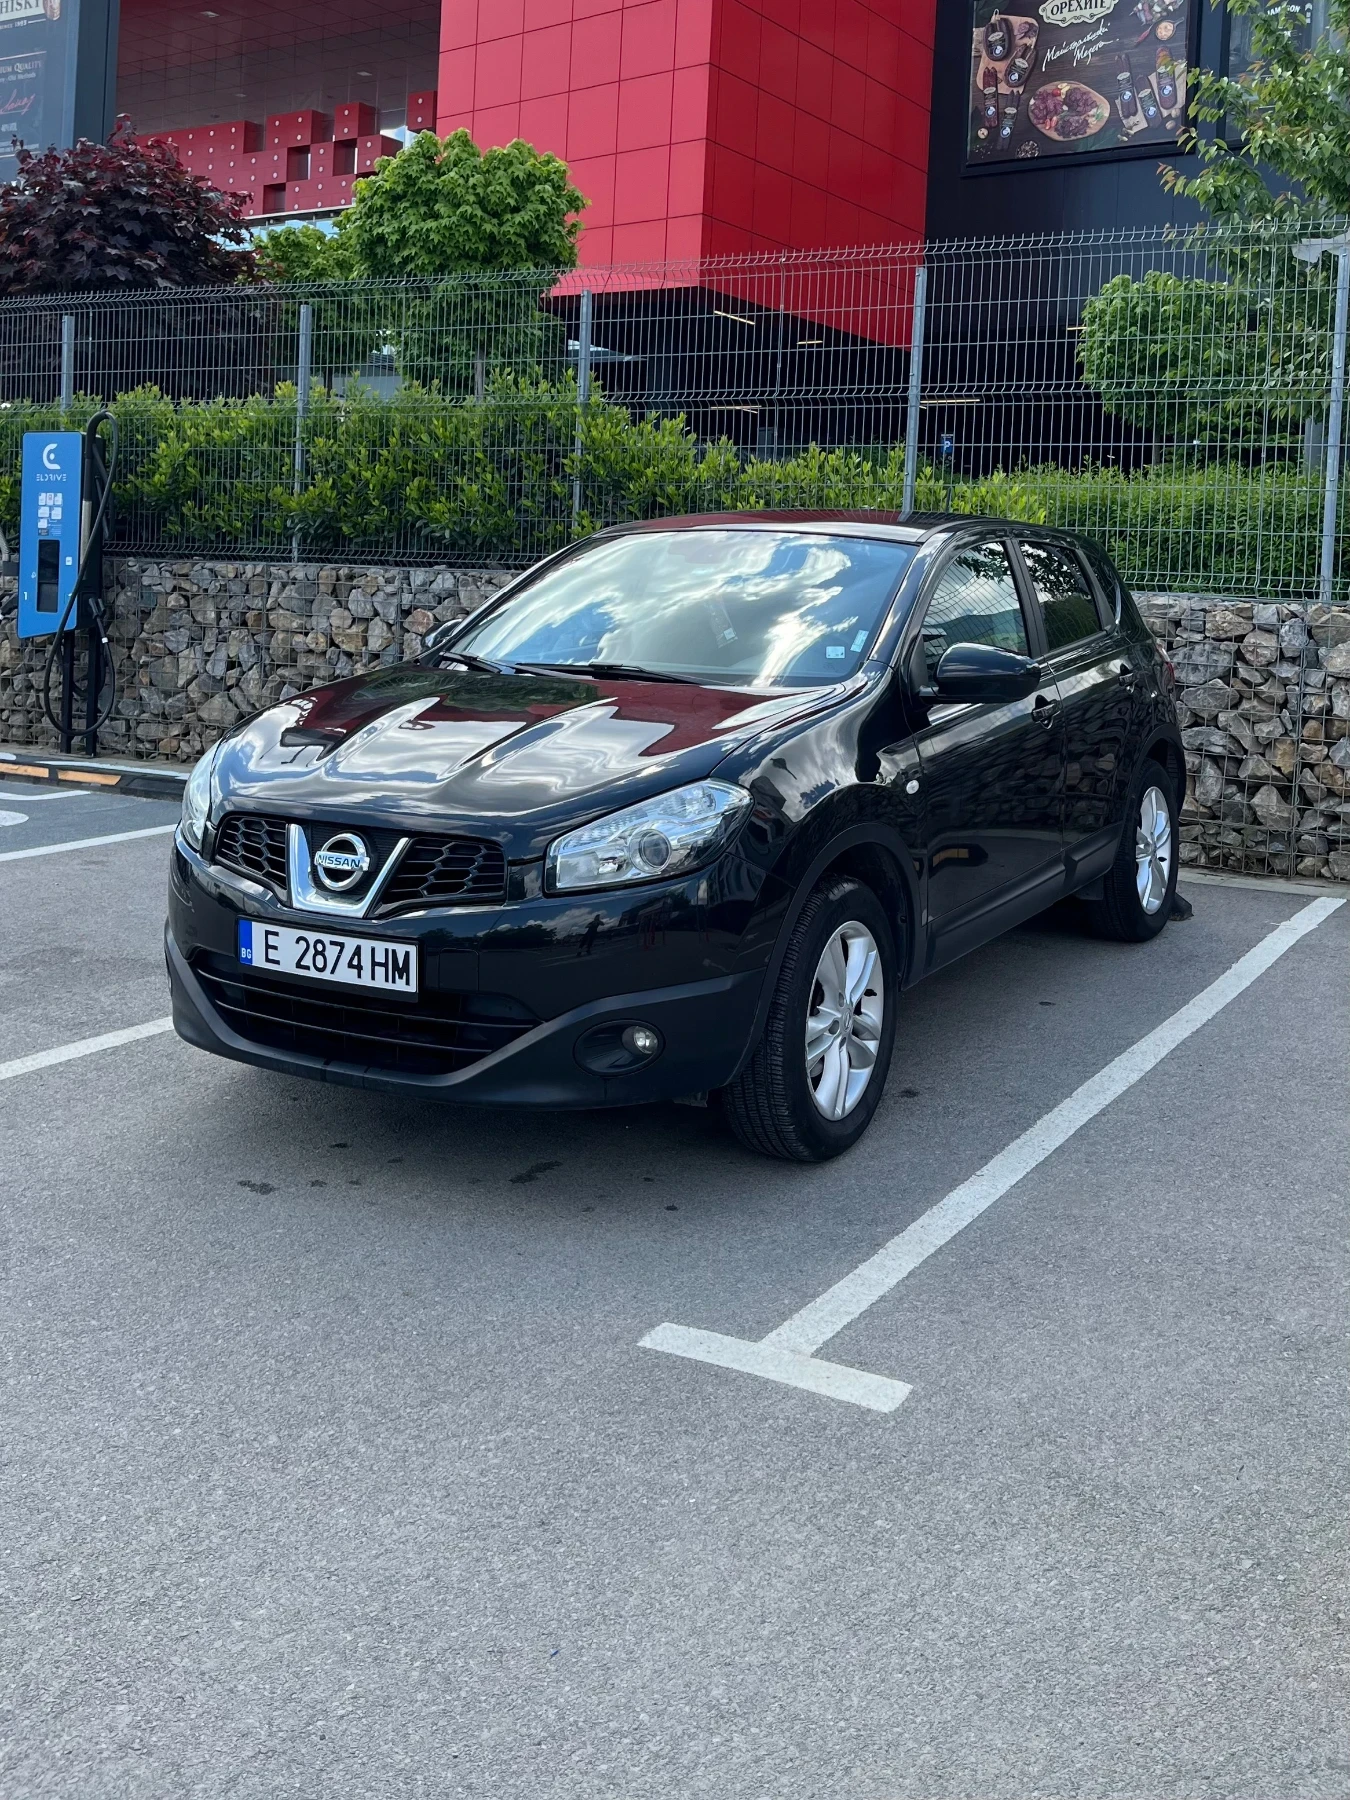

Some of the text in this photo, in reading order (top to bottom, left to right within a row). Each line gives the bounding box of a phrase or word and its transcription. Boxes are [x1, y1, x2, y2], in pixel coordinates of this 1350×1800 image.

[1051, 0, 1107, 16] ОРЕХИТЕ
[36, 473, 67, 482] ELDRIVE
[317, 855, 362, 868] NISSAN
[241, 947, 252, 960] BG
[264, 930, 281, 965] E
[296, 936, 363, 979] 2874
